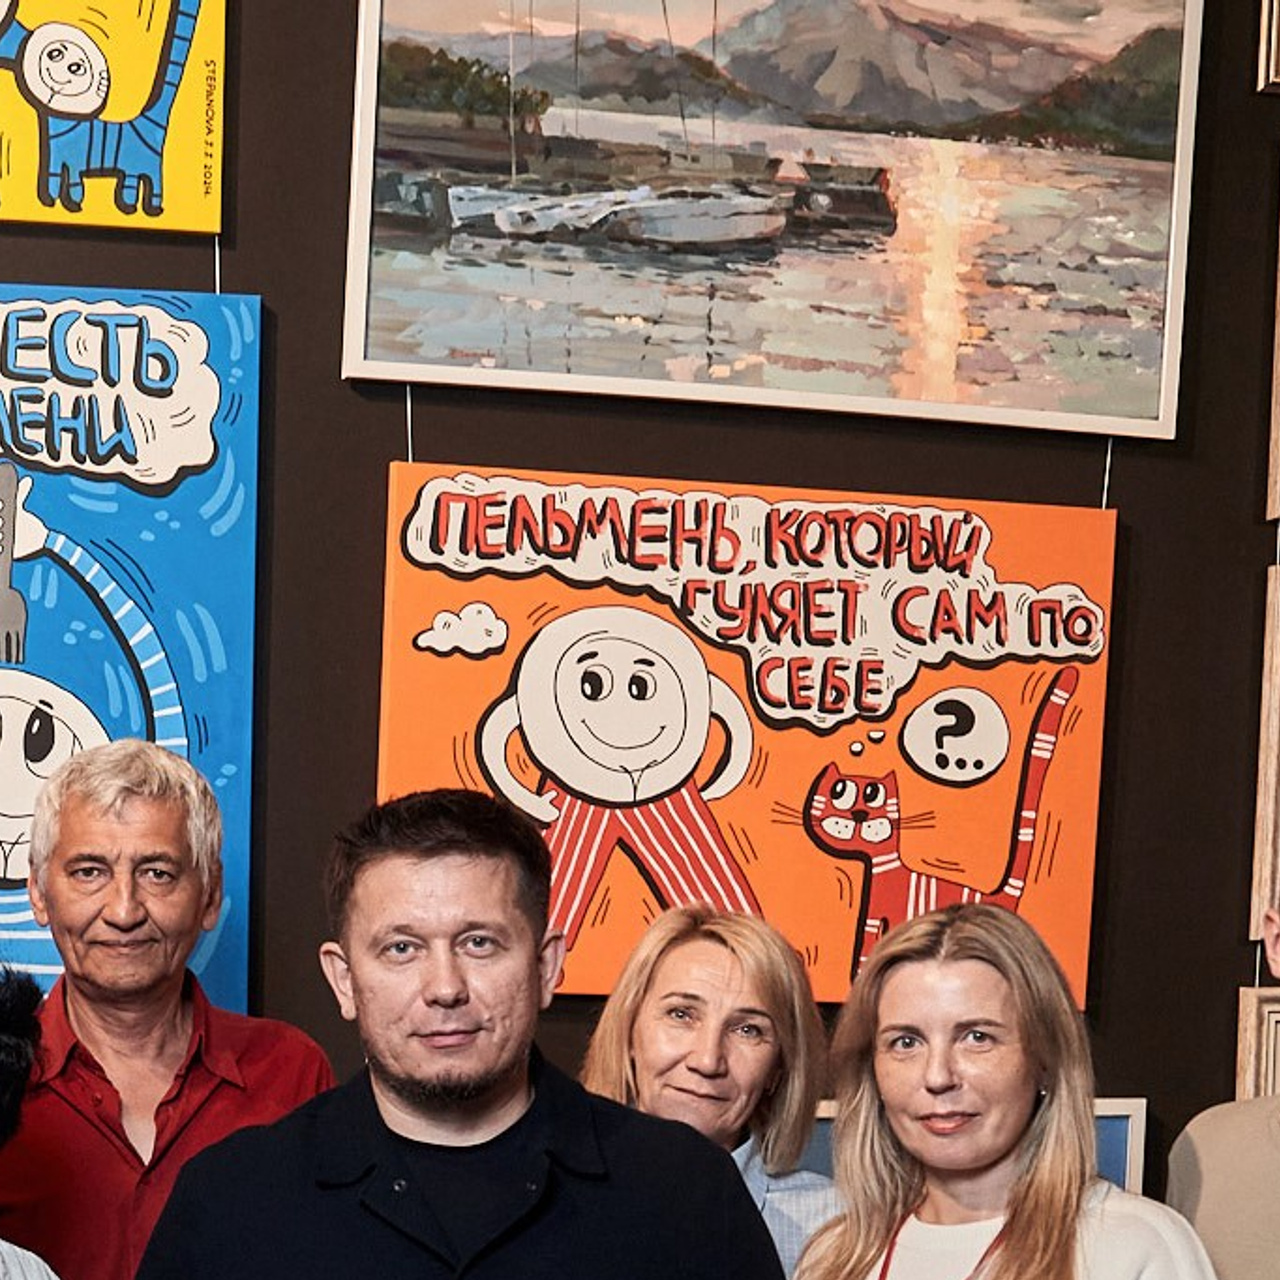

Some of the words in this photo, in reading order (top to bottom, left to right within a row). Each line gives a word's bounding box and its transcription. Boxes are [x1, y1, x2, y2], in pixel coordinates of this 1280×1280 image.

[204, 59, 217, 136] STEPANOVA
[0, 307, 179, 398] ЕСТЬ
[429, 490, 757, 576] ПЕЛЬМЕНЬ,
[765, 507, 983, 577] КОТОРЫЙ
[680, 578, 870, 647] ГУЛЯЕТ
[891, 585, 1009, 647] САМ
[1027, 599, 1096, 647] ПО
[755, 655, 885, 714] СЕБЕ
